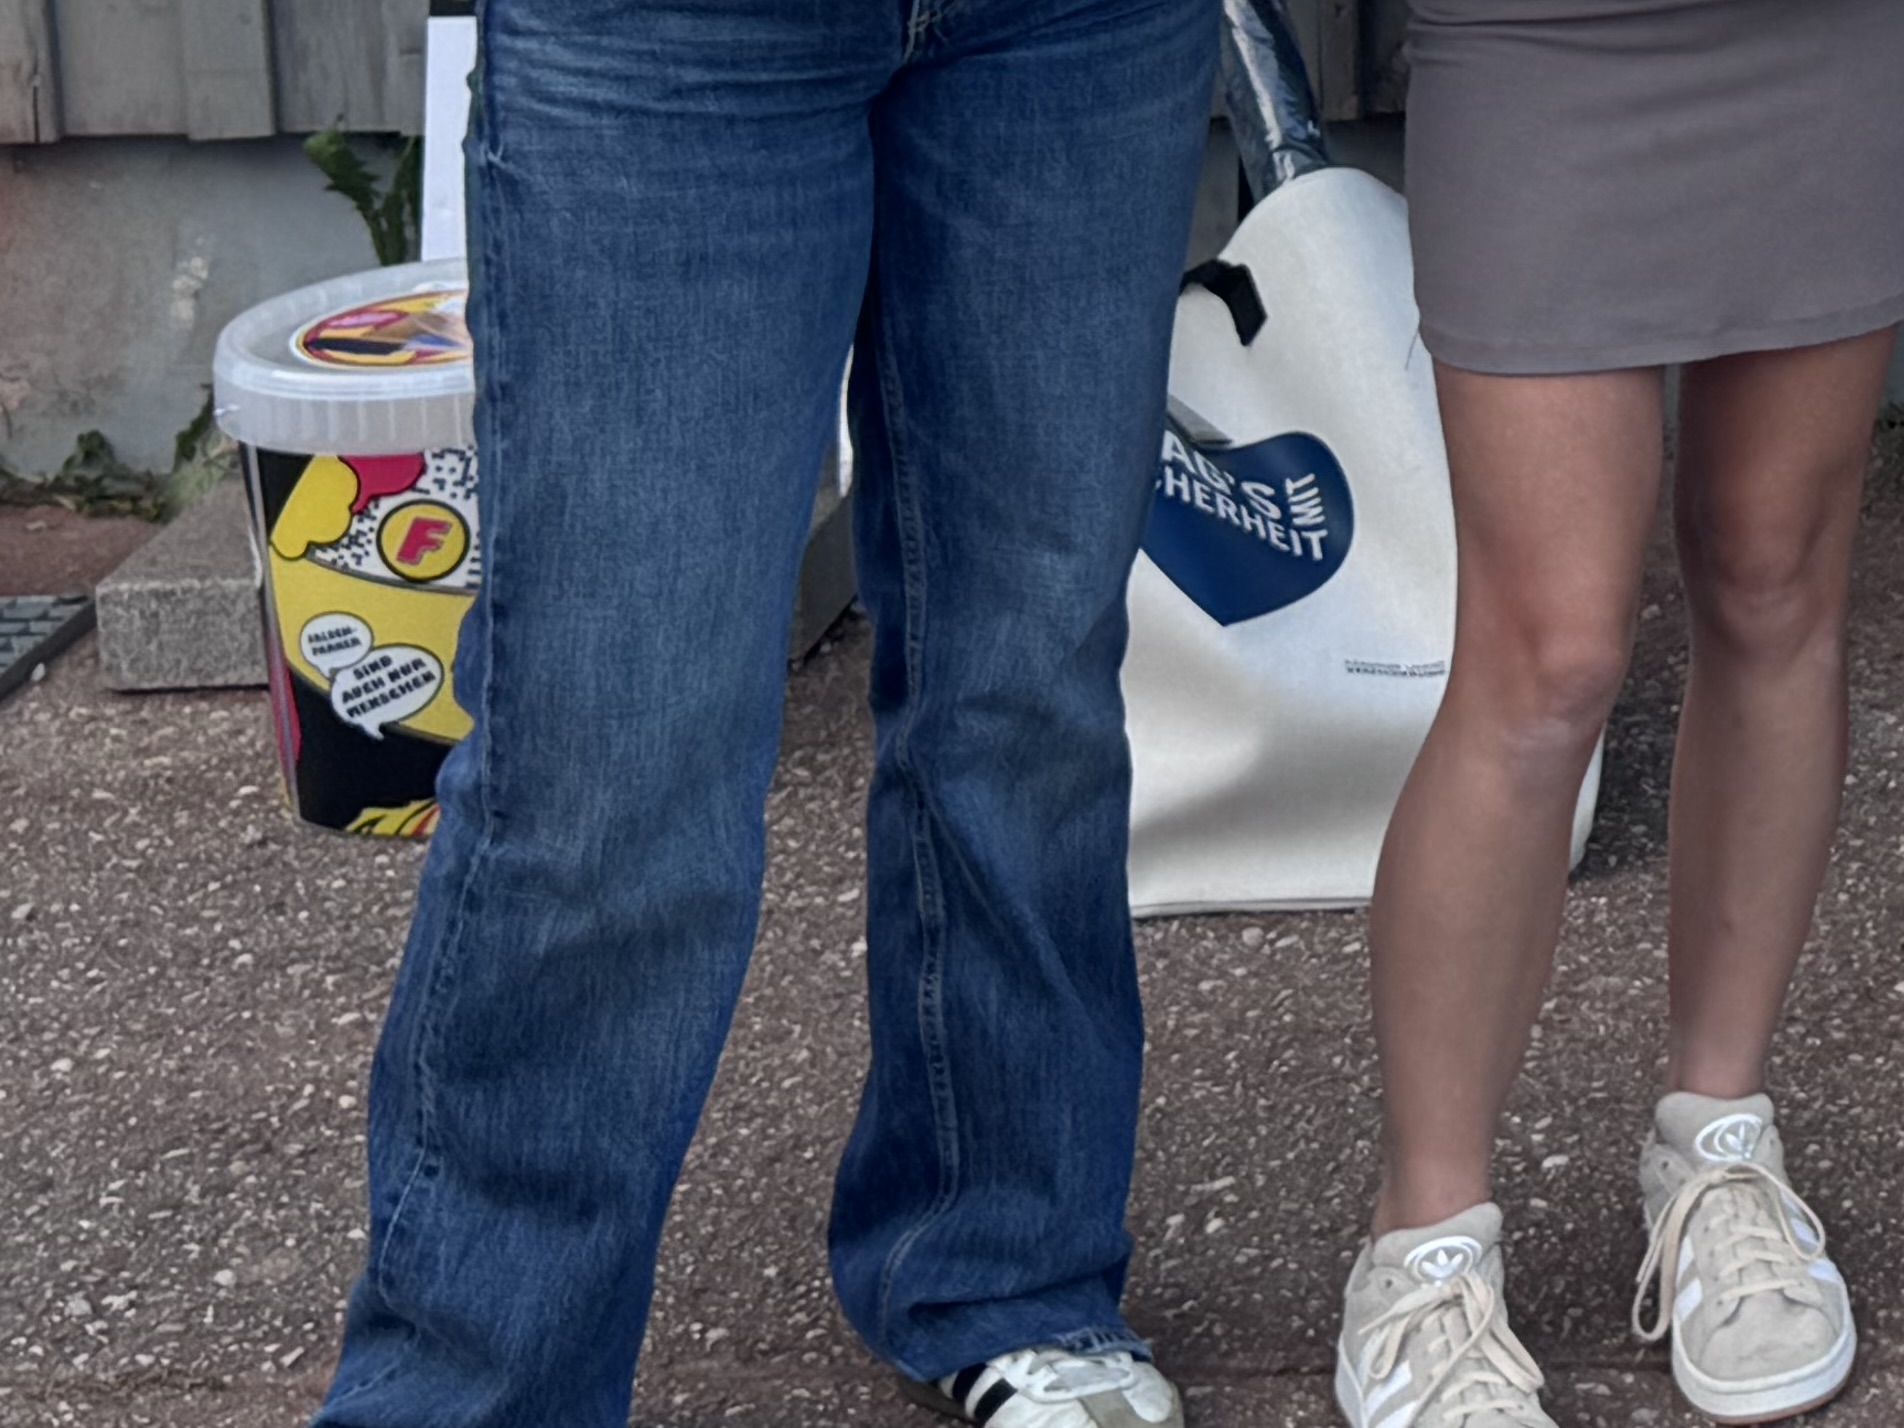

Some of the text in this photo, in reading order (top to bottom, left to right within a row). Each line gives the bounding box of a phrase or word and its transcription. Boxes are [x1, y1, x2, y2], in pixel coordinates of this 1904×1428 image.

[1161, 429, 1282, 520] AG'S
[1285, 473, 1327, 526] MIT
[1155, 465, 1329, 561] HERHEIT
[395, 515, 453, 566] F
[341, 676, 387, 705] AUCH
[353, 654, 393, 681] SIND
[345, 670, 437, 719] MENSCHEN
